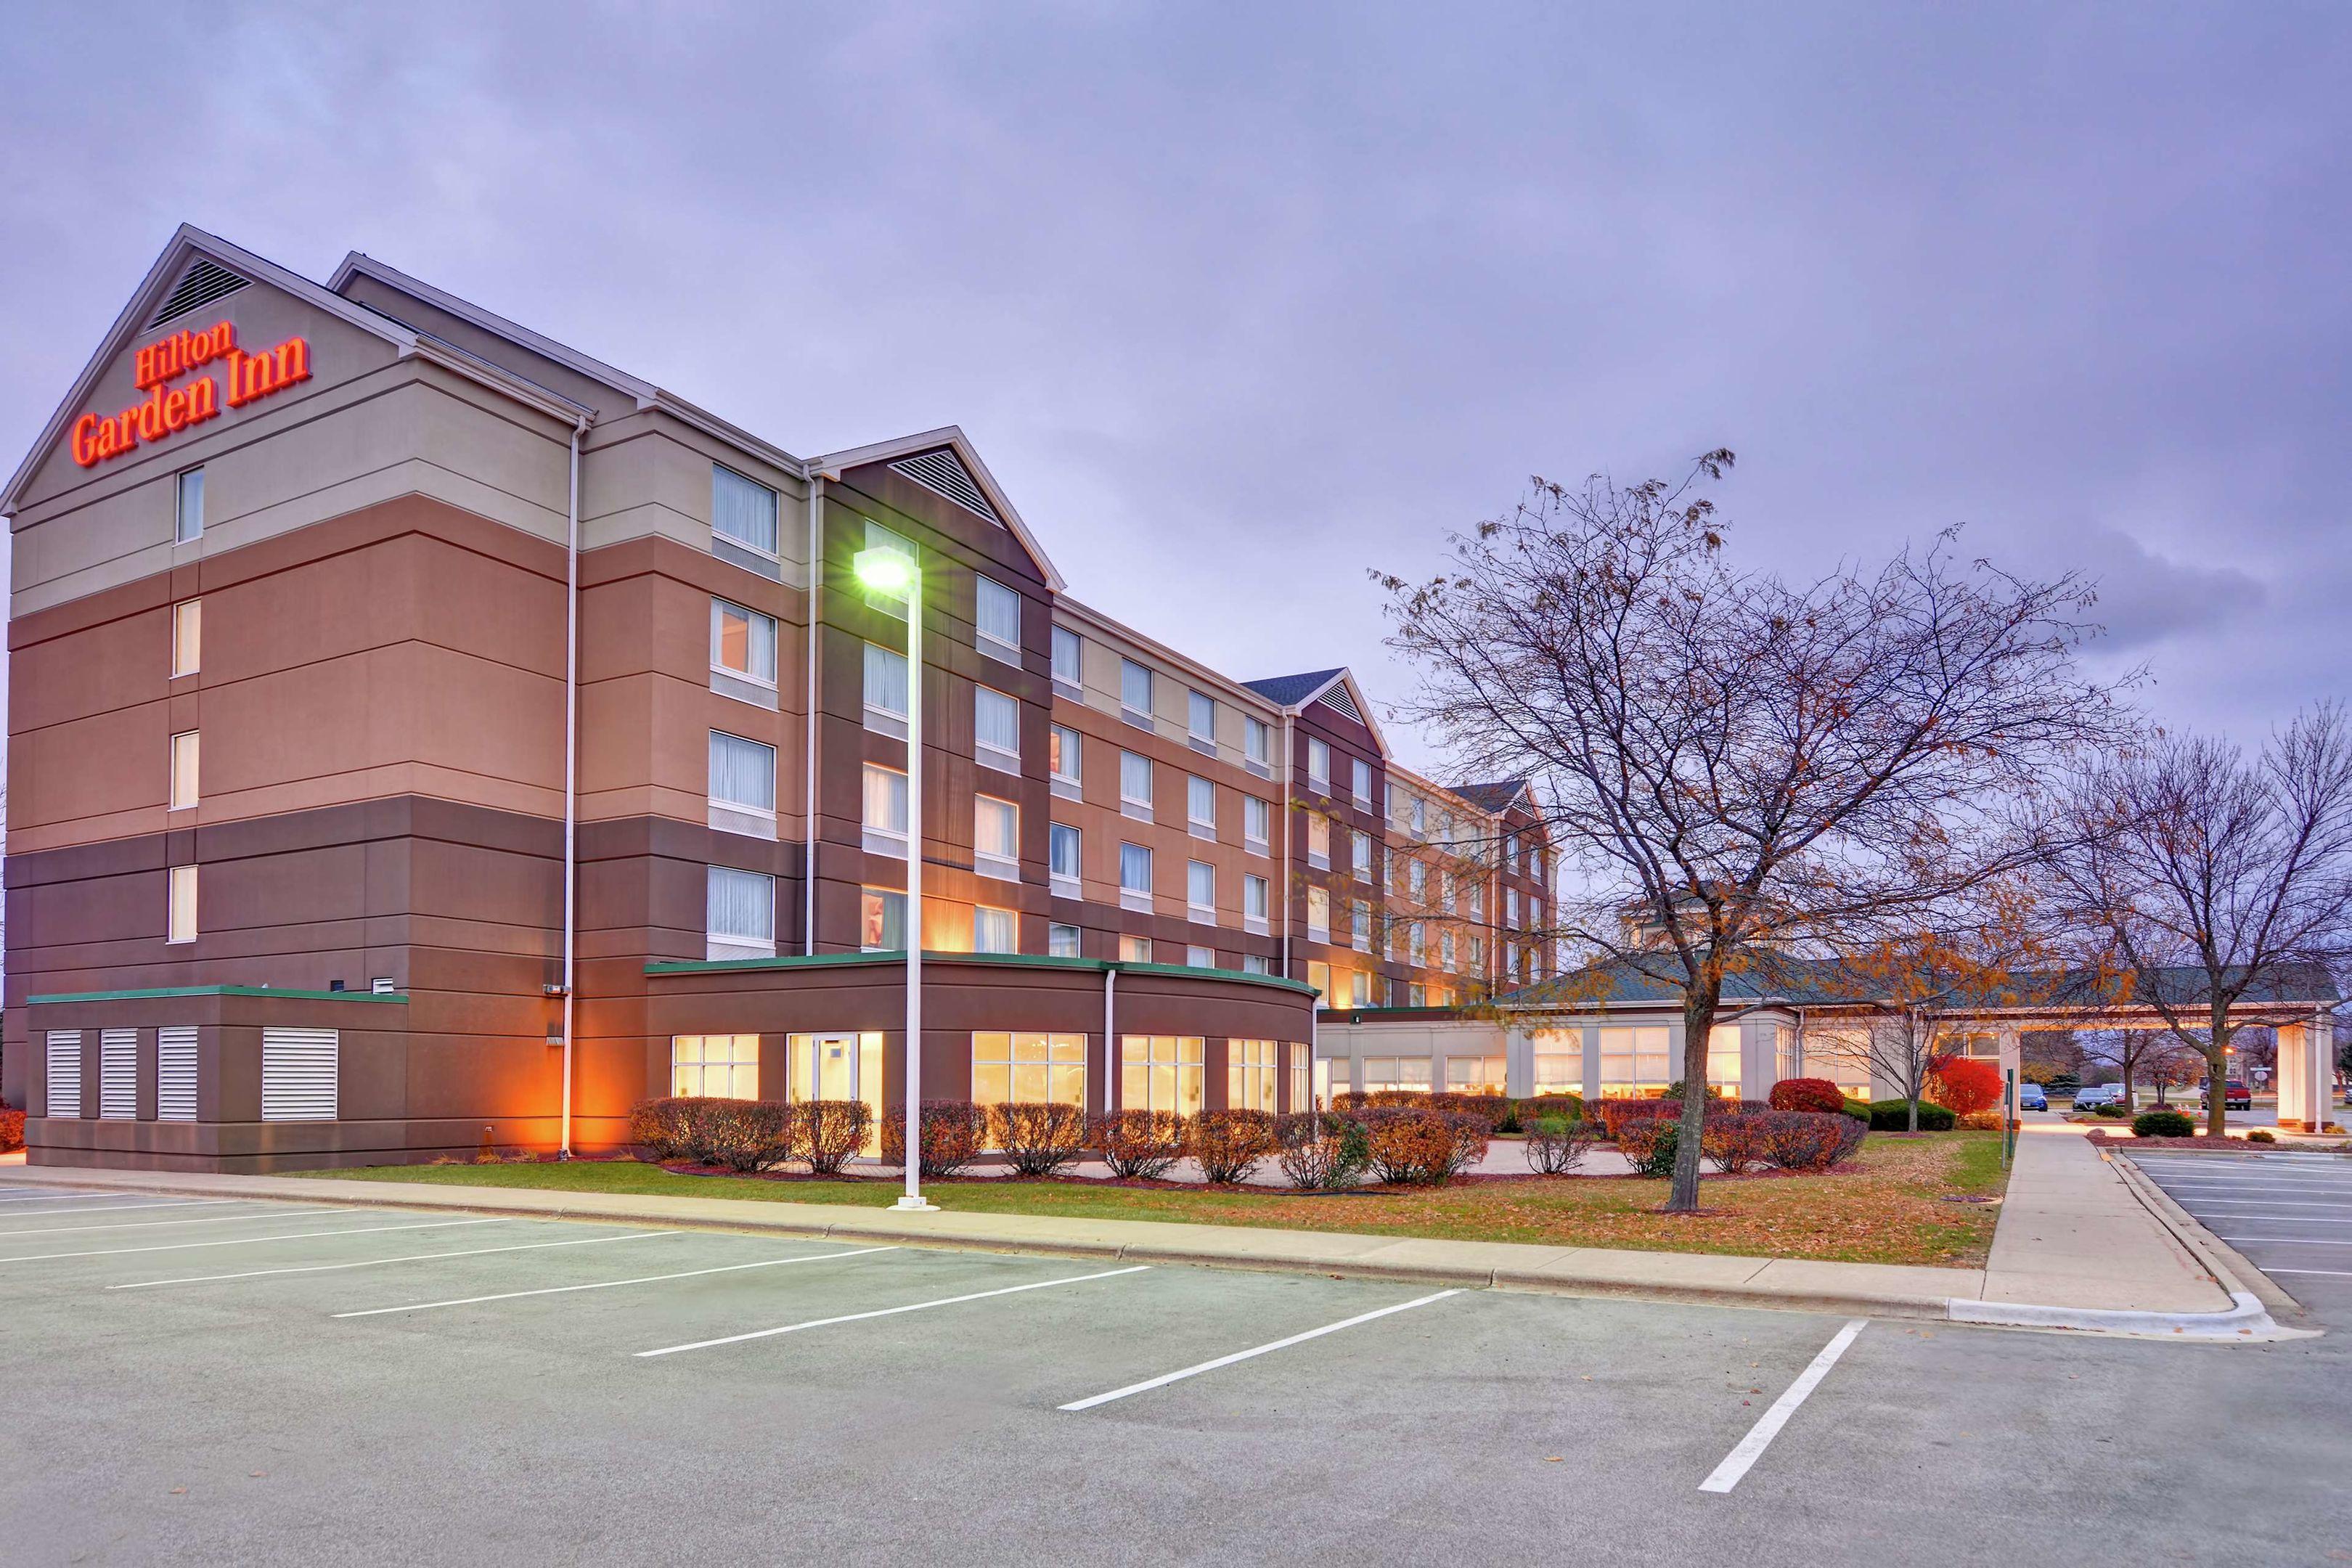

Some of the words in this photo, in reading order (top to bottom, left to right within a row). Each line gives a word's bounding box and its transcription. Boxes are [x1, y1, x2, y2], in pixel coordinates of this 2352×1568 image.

[72, 376, 221, 467] Garden
[226, 337, 313, 408] Inn
[135, 320, 236, 390] Hilton
